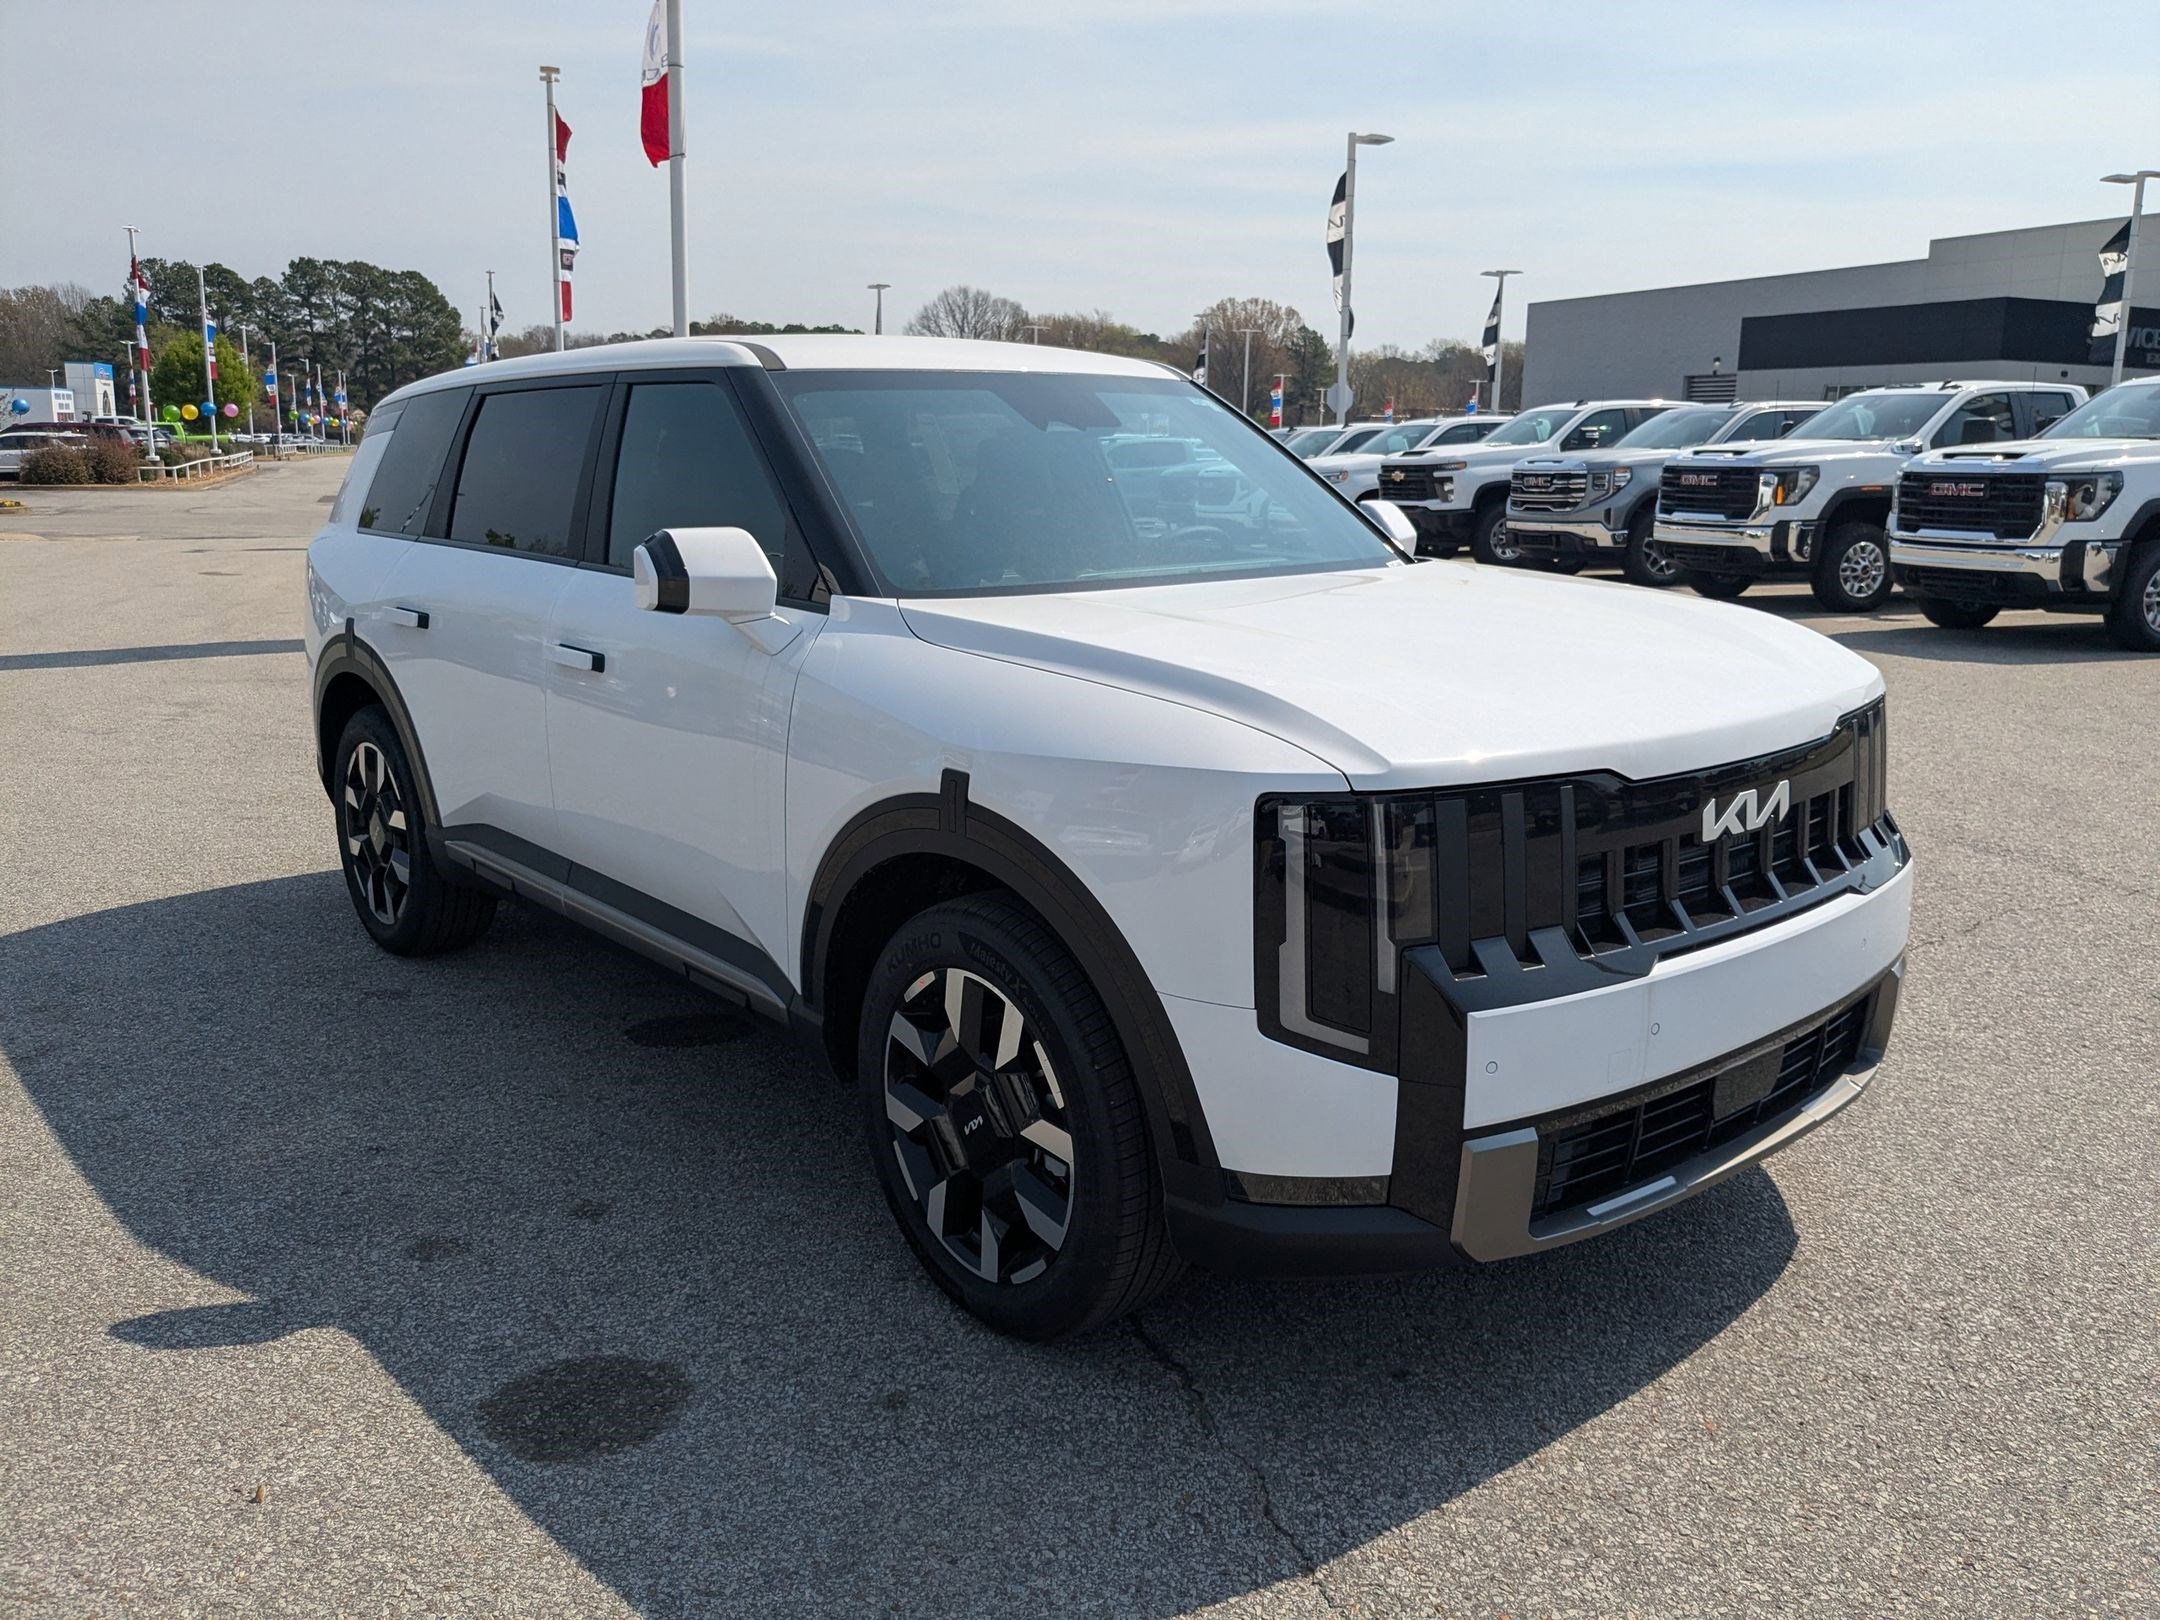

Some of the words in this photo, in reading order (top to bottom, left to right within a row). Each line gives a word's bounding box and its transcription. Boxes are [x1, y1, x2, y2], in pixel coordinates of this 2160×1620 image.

[1524, 476, 1551, 487] GMC
[1680, 474, 1718, 486] GMC
[1930, 482, 1985, 497] GMC
[1702, 779, 1790, 842] KIA
[886, 931, 942, 976] KUMHO
[967, 943, 1013, 983] Majesty
